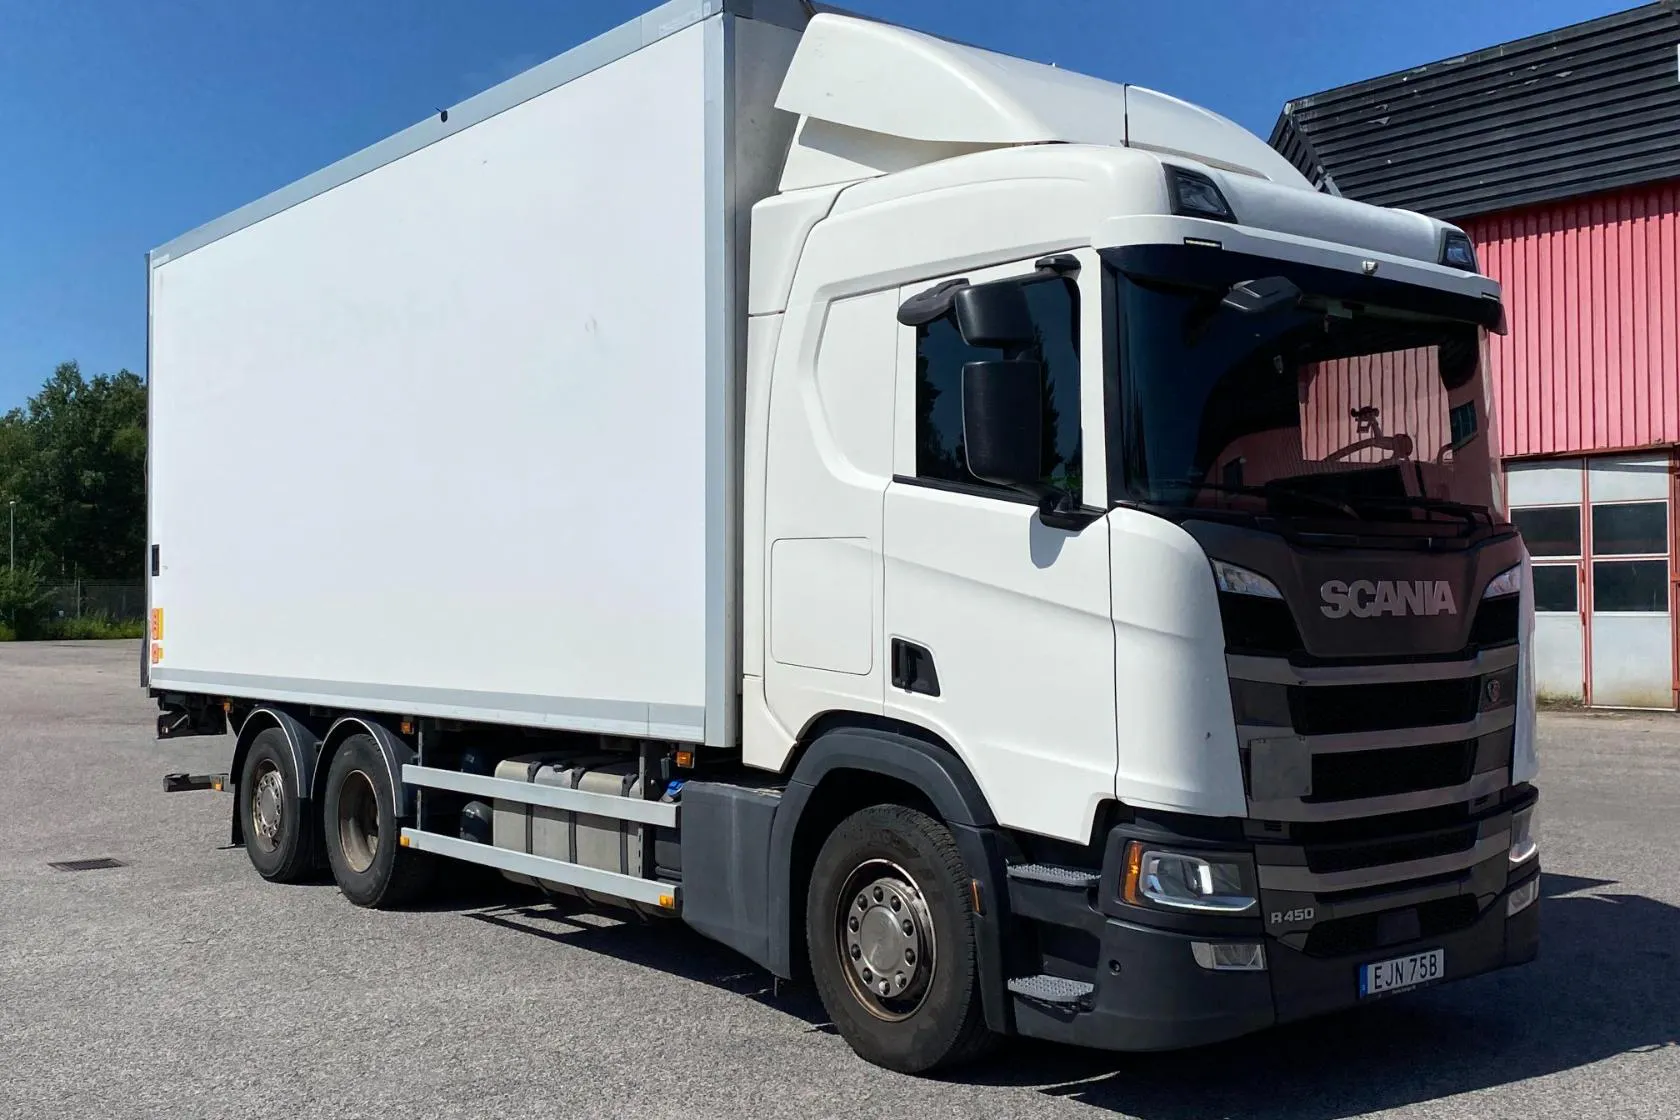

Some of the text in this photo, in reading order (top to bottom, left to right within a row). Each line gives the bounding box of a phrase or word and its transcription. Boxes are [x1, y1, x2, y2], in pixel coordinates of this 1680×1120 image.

[1319, 579, 1457, 619] SCANIA
[1375, 954, 1437, 989] EJN 75B
